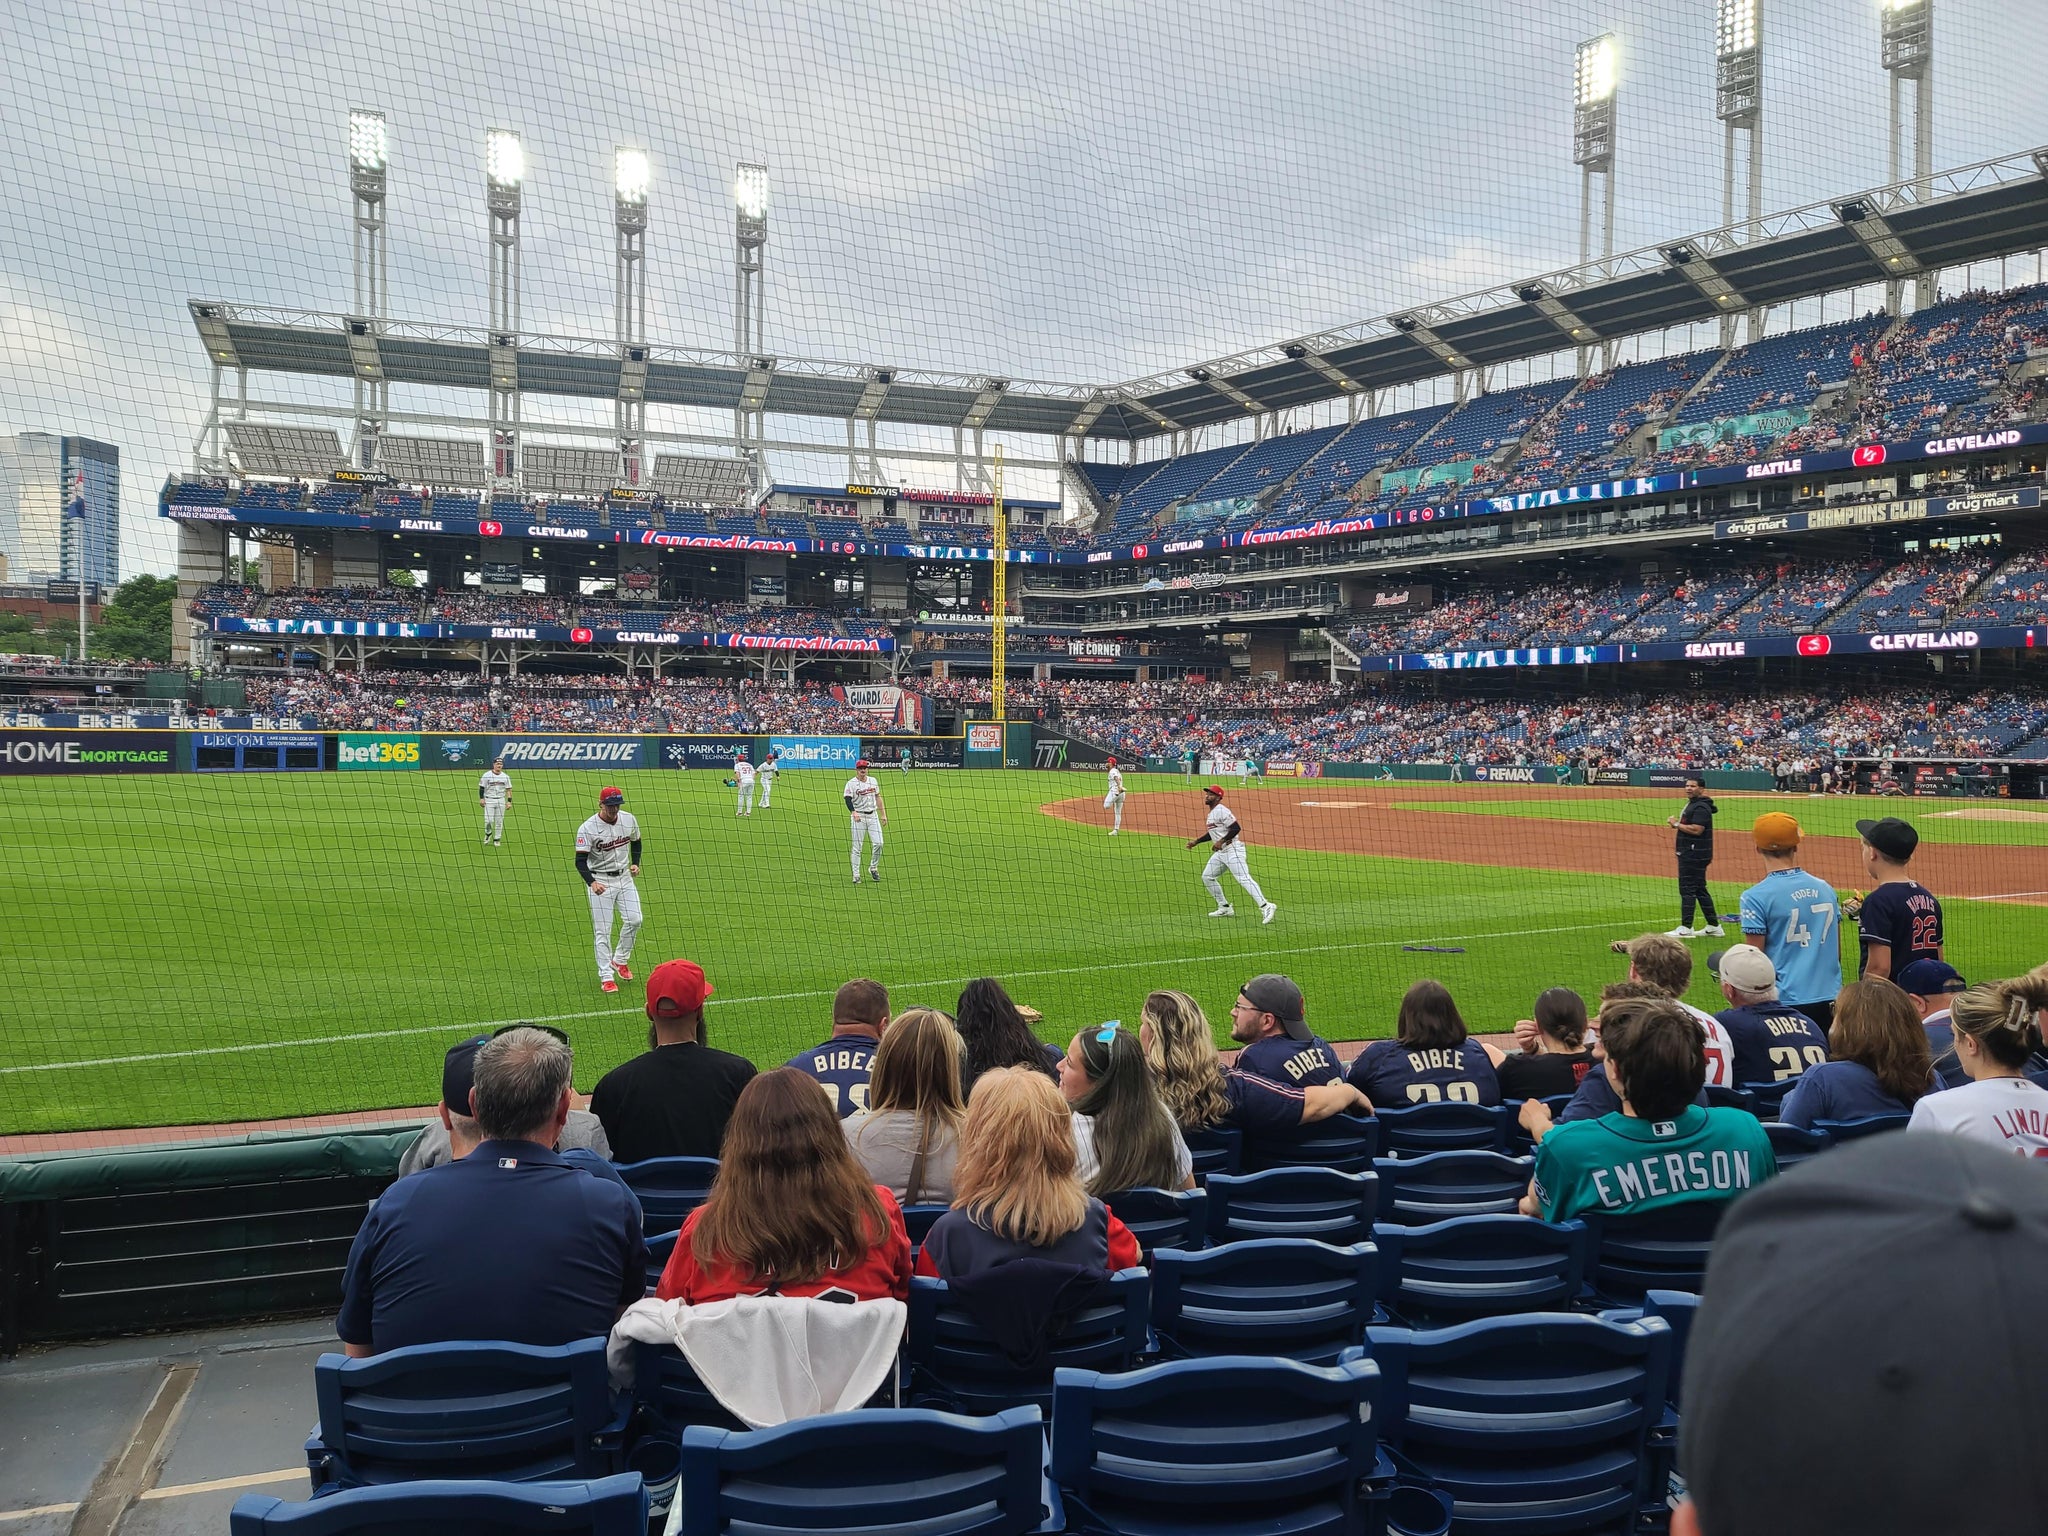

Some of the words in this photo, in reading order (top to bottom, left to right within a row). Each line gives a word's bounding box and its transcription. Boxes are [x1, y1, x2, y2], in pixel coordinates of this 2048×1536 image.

[1756, 416, 1793, 431] WYNN
[1925, 430, 2021, 454] CLEVELAND
[1746, 459, 1802, 478] SEATTLE
[903, 488, 950, 501] PENNANT
[952, 491, 995, 504] DISTRICT
[1946, 500, 1980, 512] drug
[1982, 493, 2019, 508] mart
[1967, 492, 1997, 500] DISCOUNT
[1807, 504, 1887, 529] CHAMPIONS
[1890, 500, 1927, 519] CLUB
[400, 520, 442, 531] SEATTLE
[528, 526, 588, 538] CLEVELAND
[1727, 522, 1756, 534] drug
[1757, 518, 1788, 530] mart
[1163, 540, 1204, 554] CLEVELAND
[1088, 551, 1112, 562] SEATTLE
[1172, 577, 1191, 588] kids
[932, 612, 948, 621] FAT
[491, 628, 536, 639] SEATTLE
[616, 631, 680, 644] CLEVELAND
[1870, 631, 1979, 650] CLEVELAND
[1068, 642, 1084, 655] THE
[1086, 643, 1121, 656] CORNER
[1684, 642, 1745, 658] SEATTLE
[850, 691, 880, 706] GUARDS
[972, 728, 996, 740] drug
[688, 744, 714, 754] PARK
[716, 745, 748, 754] PLE
[973, 738, 1000, 748] mart
[80, 750, 168, 762] MORTGAGE
[339, 742, 418, 762] bet365
[500, 742, 634, 761] PROGRESSIVE
[773, 744, 856, 761] DollarBank
[1791, 888, 1819, 901] FODEN
[1786, 902, 1834, 948] 47
[1912, 916, 1938, 950] 22
[1764, 1016, 1812, 1038] BIBEE
[1282, 1048, 1330, 1082] BIBEE
[1407, 1048, 1465, 1073] BIBEE
[1591, 1150, 1752, 1209] EMERSON
